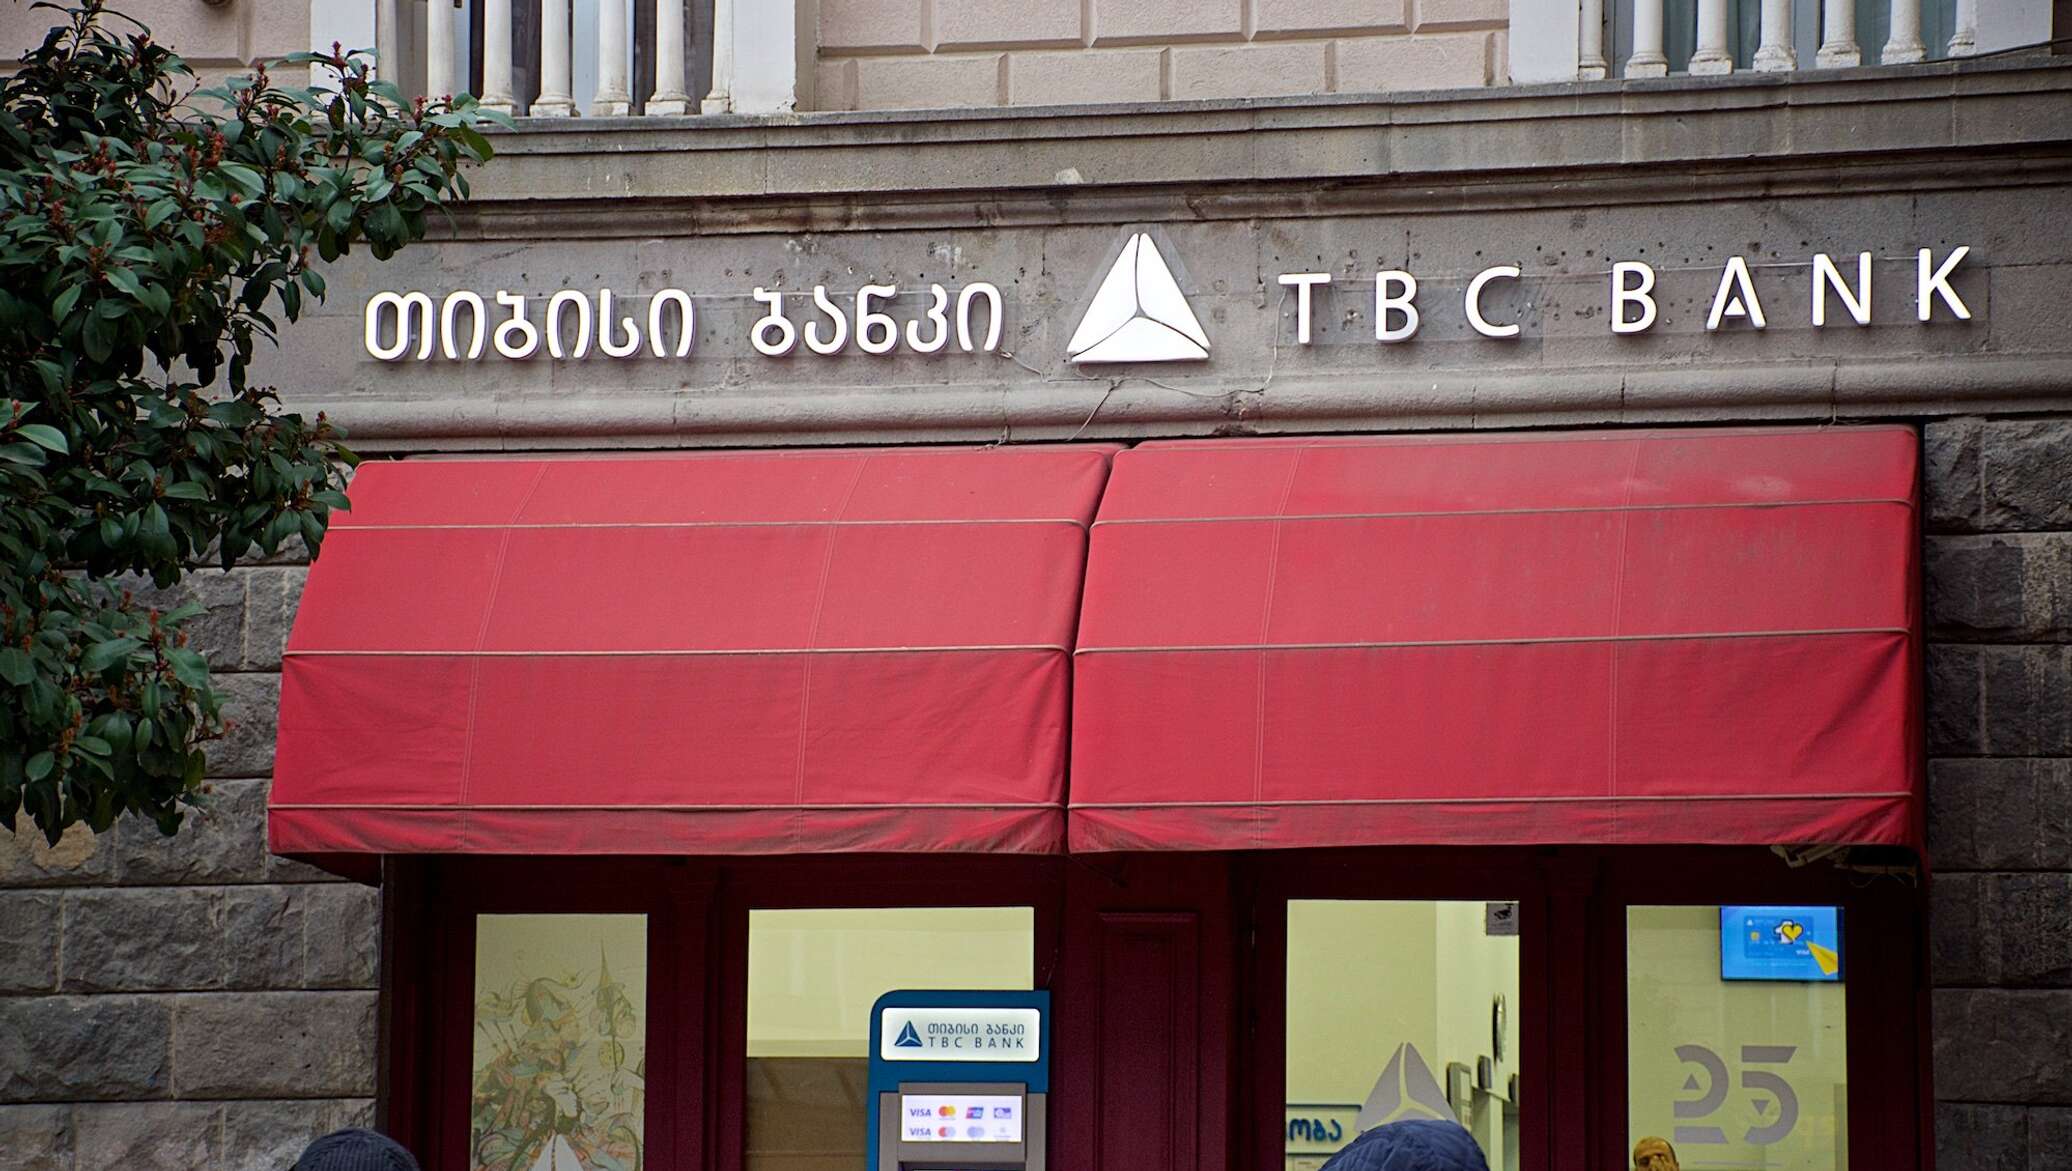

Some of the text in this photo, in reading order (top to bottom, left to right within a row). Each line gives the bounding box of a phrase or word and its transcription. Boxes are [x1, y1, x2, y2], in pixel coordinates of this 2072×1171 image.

[1279, 246, 1971, 345] TBC BANK
[364, 281, 1004, 361] თიბისი ბანკი
[928, 1023, 1024, 1035] თიბისი ბანკი
[929, 1036, 1024, 1048] TBC BANK
[1673, 1044, 1798, 1145] 25
[910, 1108, 931, 1117] VISA
[910, 1127, 931, 1136] VISA
